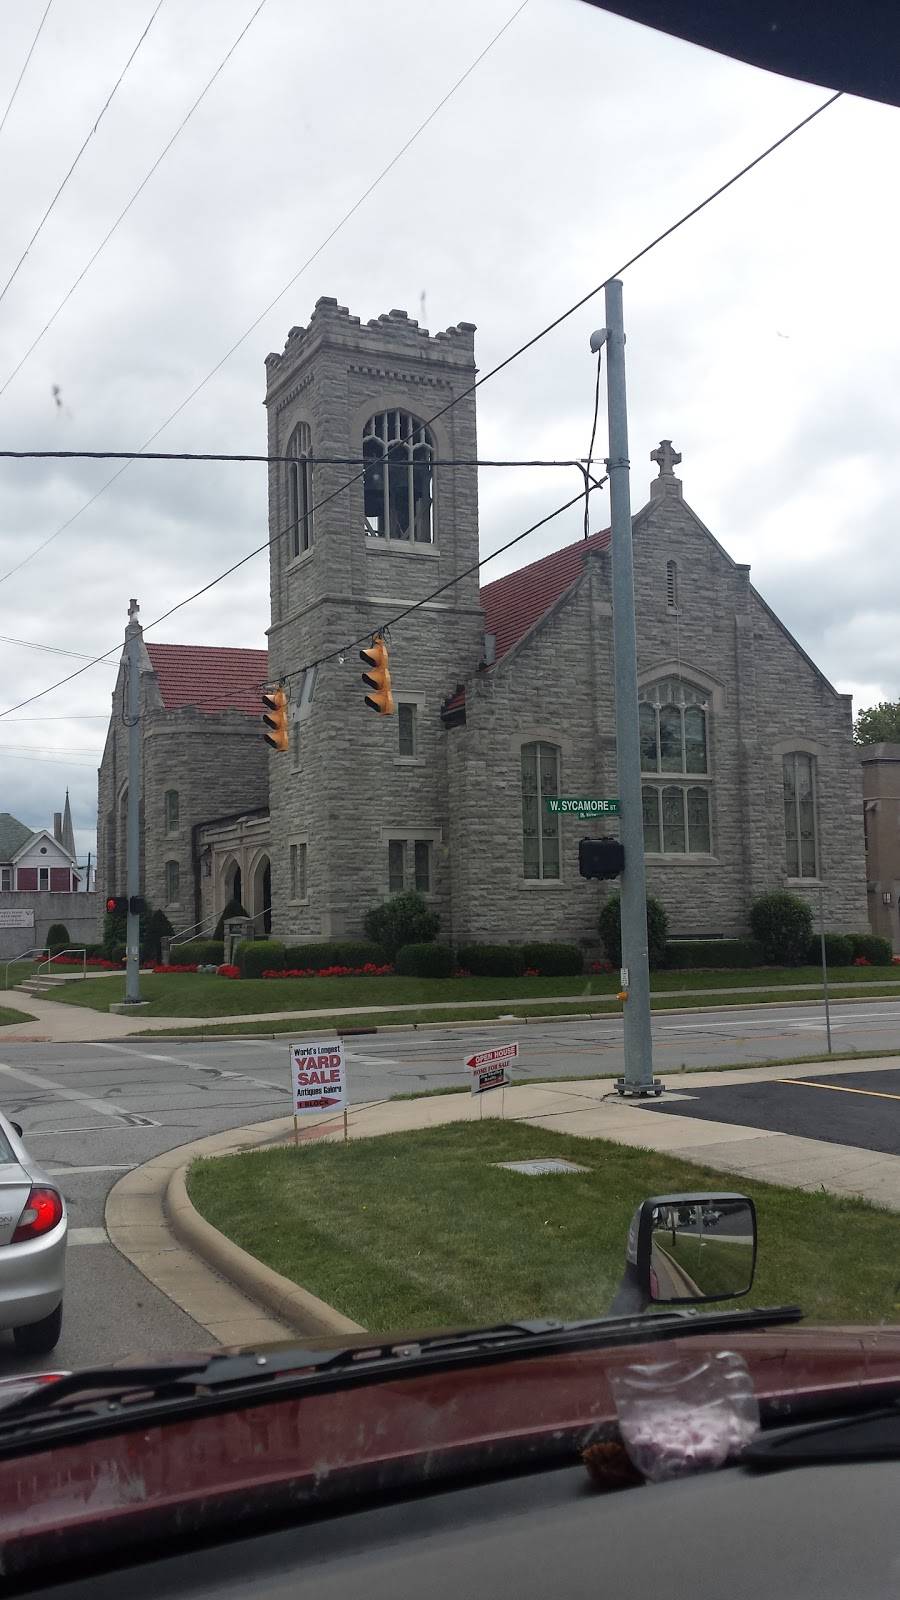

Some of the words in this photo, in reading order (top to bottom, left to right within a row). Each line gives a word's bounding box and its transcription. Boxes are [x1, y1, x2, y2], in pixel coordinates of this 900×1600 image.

[550, 801, 560, 811] W.
[561, 800, 609, 811] SYCAMORE
[294, 1047, 317, 1056] World's
[318, 1045, 341, 1055] Longest
[475, 1051, 493, 1063] OPEN
[494, 1046, 516, 1059] HOUSE
[294, 1055, 341, 1070] YARD
[297, 1069, 341, 1086] SALE
[297, 1087, 322, 1097] Antiques
[323, 1085, 342, 1094] Galore
